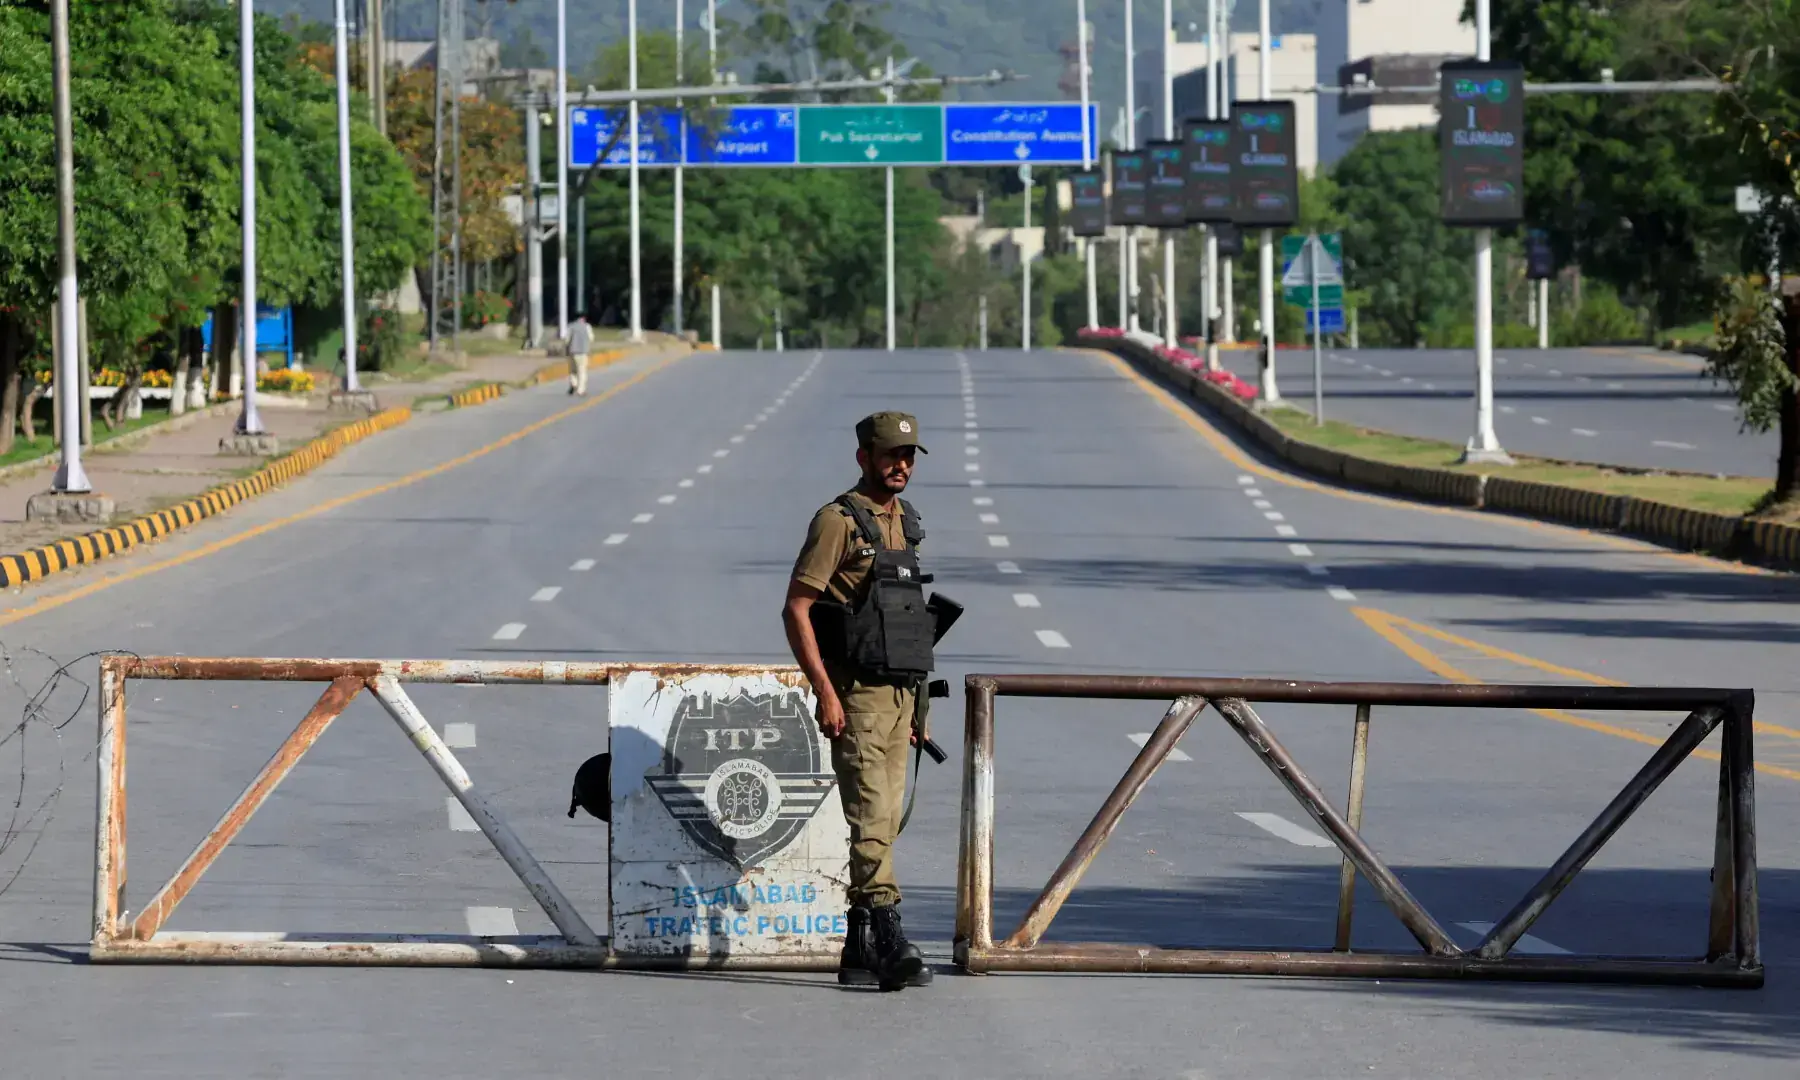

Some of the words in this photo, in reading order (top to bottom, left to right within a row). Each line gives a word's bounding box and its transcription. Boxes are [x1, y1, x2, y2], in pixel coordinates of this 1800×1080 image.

[951, 129, 1037, 143] Constitution
[715, 140, 768, 156] Airport
[703, 728, 782, 751] ITP
[716, 762, 769, 779] ISLAMABAD
[711, 809, 745, 836] TRFFIC
[747, 808, 777, 834] POLICE
[673, 884, 817, 908] ISLAMABAD
[756, 913, 847, 936] POLICE
